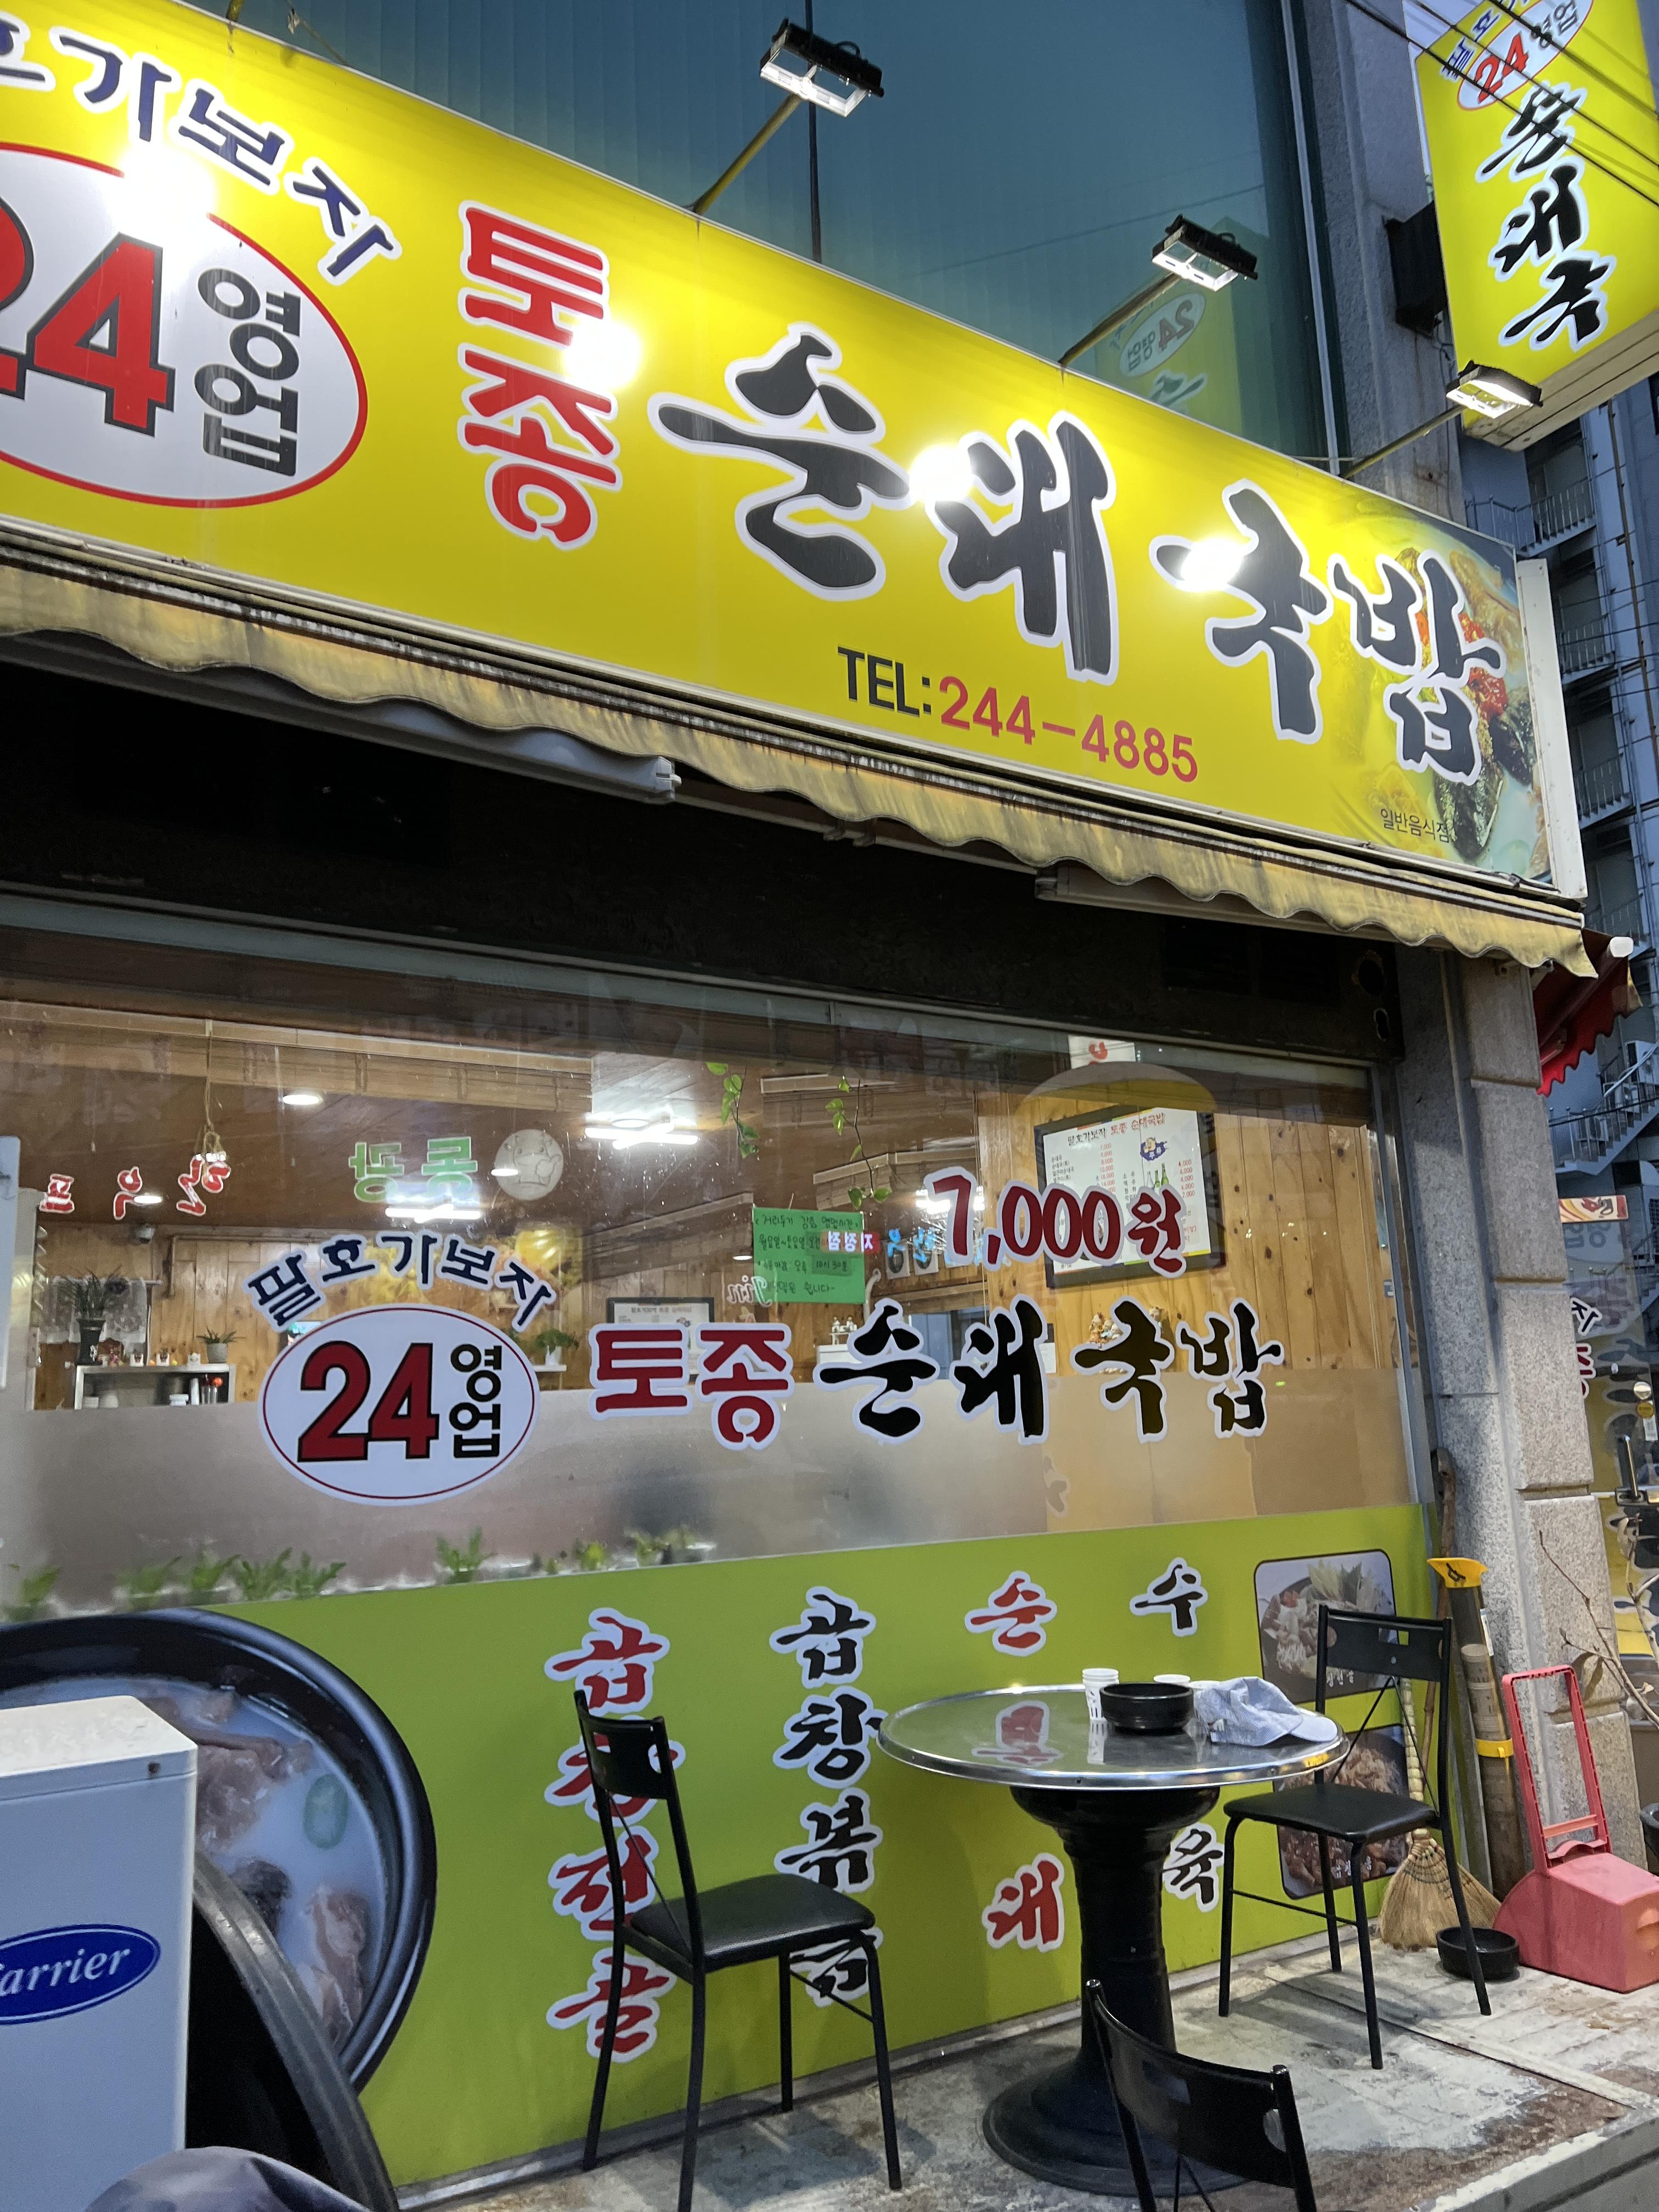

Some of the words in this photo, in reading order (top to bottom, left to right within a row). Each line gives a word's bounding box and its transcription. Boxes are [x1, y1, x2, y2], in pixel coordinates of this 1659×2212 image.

[1474, 31, 1528, 103] 24
[194, 268, 301, 476] 영업
[464, 206, 617, 543] 토종
[1380, 808, 1449, 843] 일반음식점
[1111, 1123, 1126, 1136] 토종
[1131, 1113, 1165, 1130] 순대국밥
[932, 1174, 1183, 1273] 7,000원
[248, 1234, 552, 1327] 팔호가보자
[297, 1340, 439, 1463] 24
[449, 1343, 503, 1459] 영업
[595, 1329, 789, 1442] 토종
[0, 1948, 131, 1997] arrier
